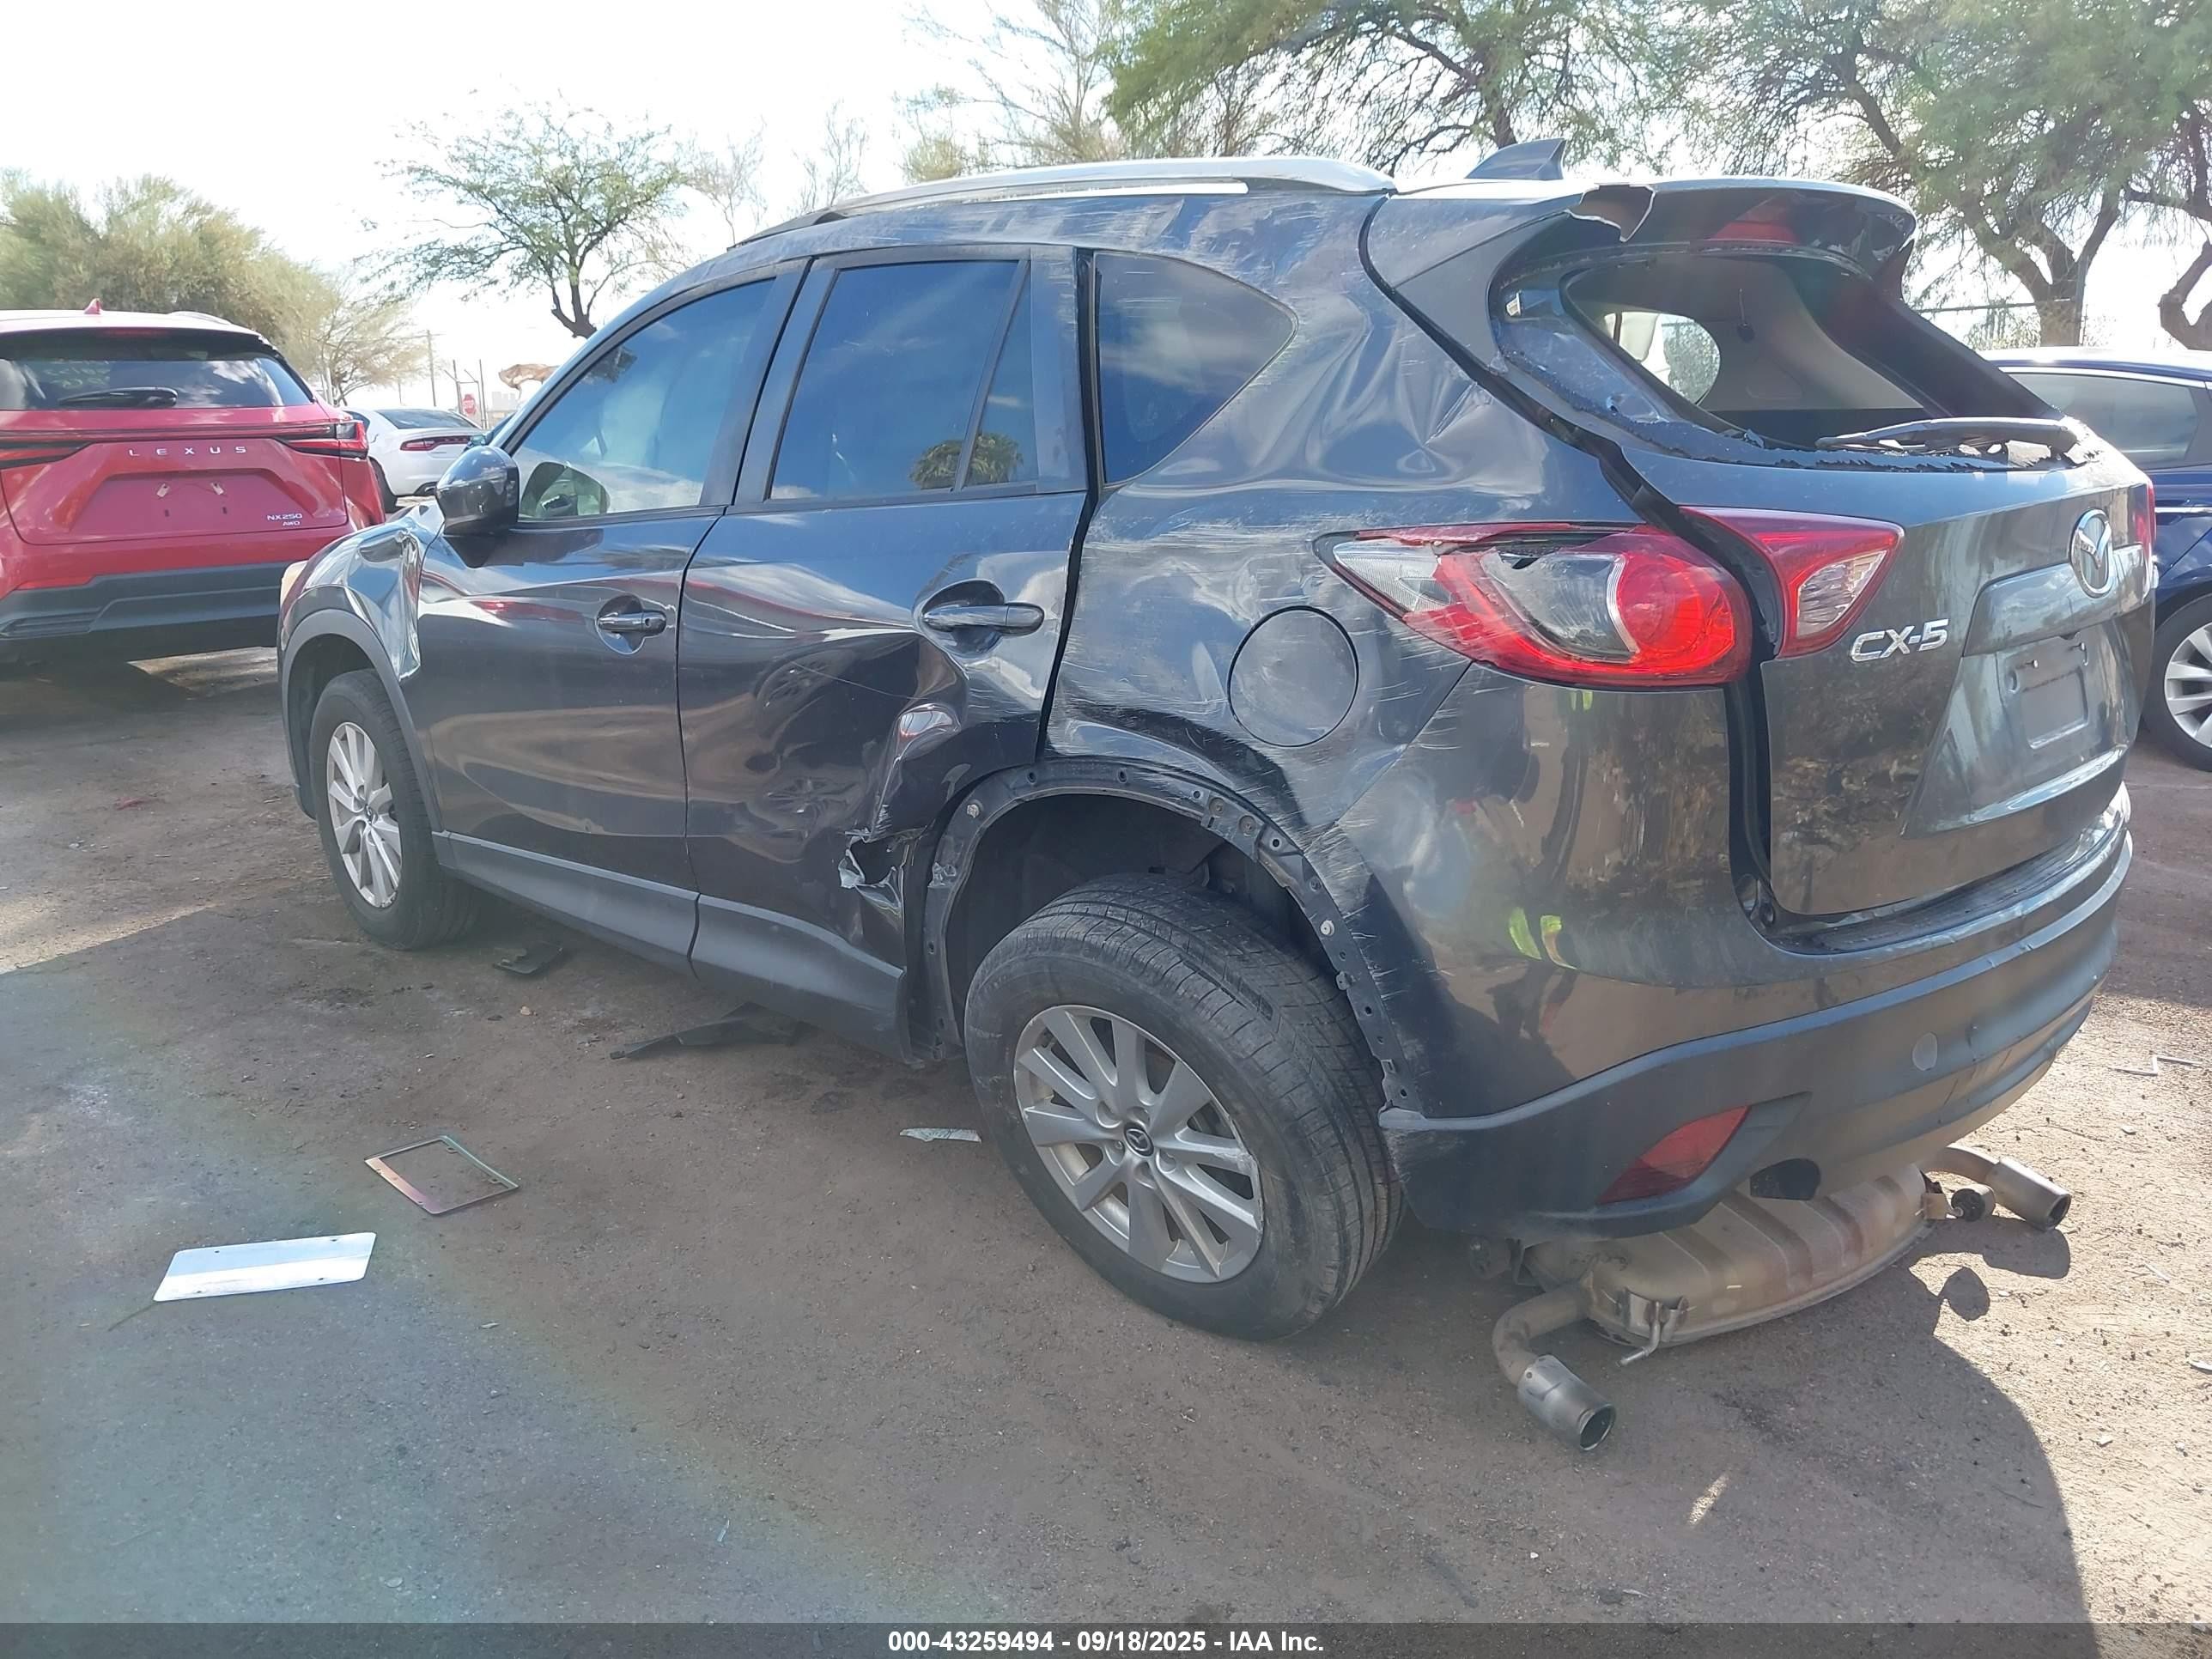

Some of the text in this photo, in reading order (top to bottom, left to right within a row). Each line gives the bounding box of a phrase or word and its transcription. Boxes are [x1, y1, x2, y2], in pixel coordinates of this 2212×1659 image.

[129, 446, 246, 457] LEXUS
[266, 513, 303, 521] NX250
[1850, 618, 1949, 662] CX-5
